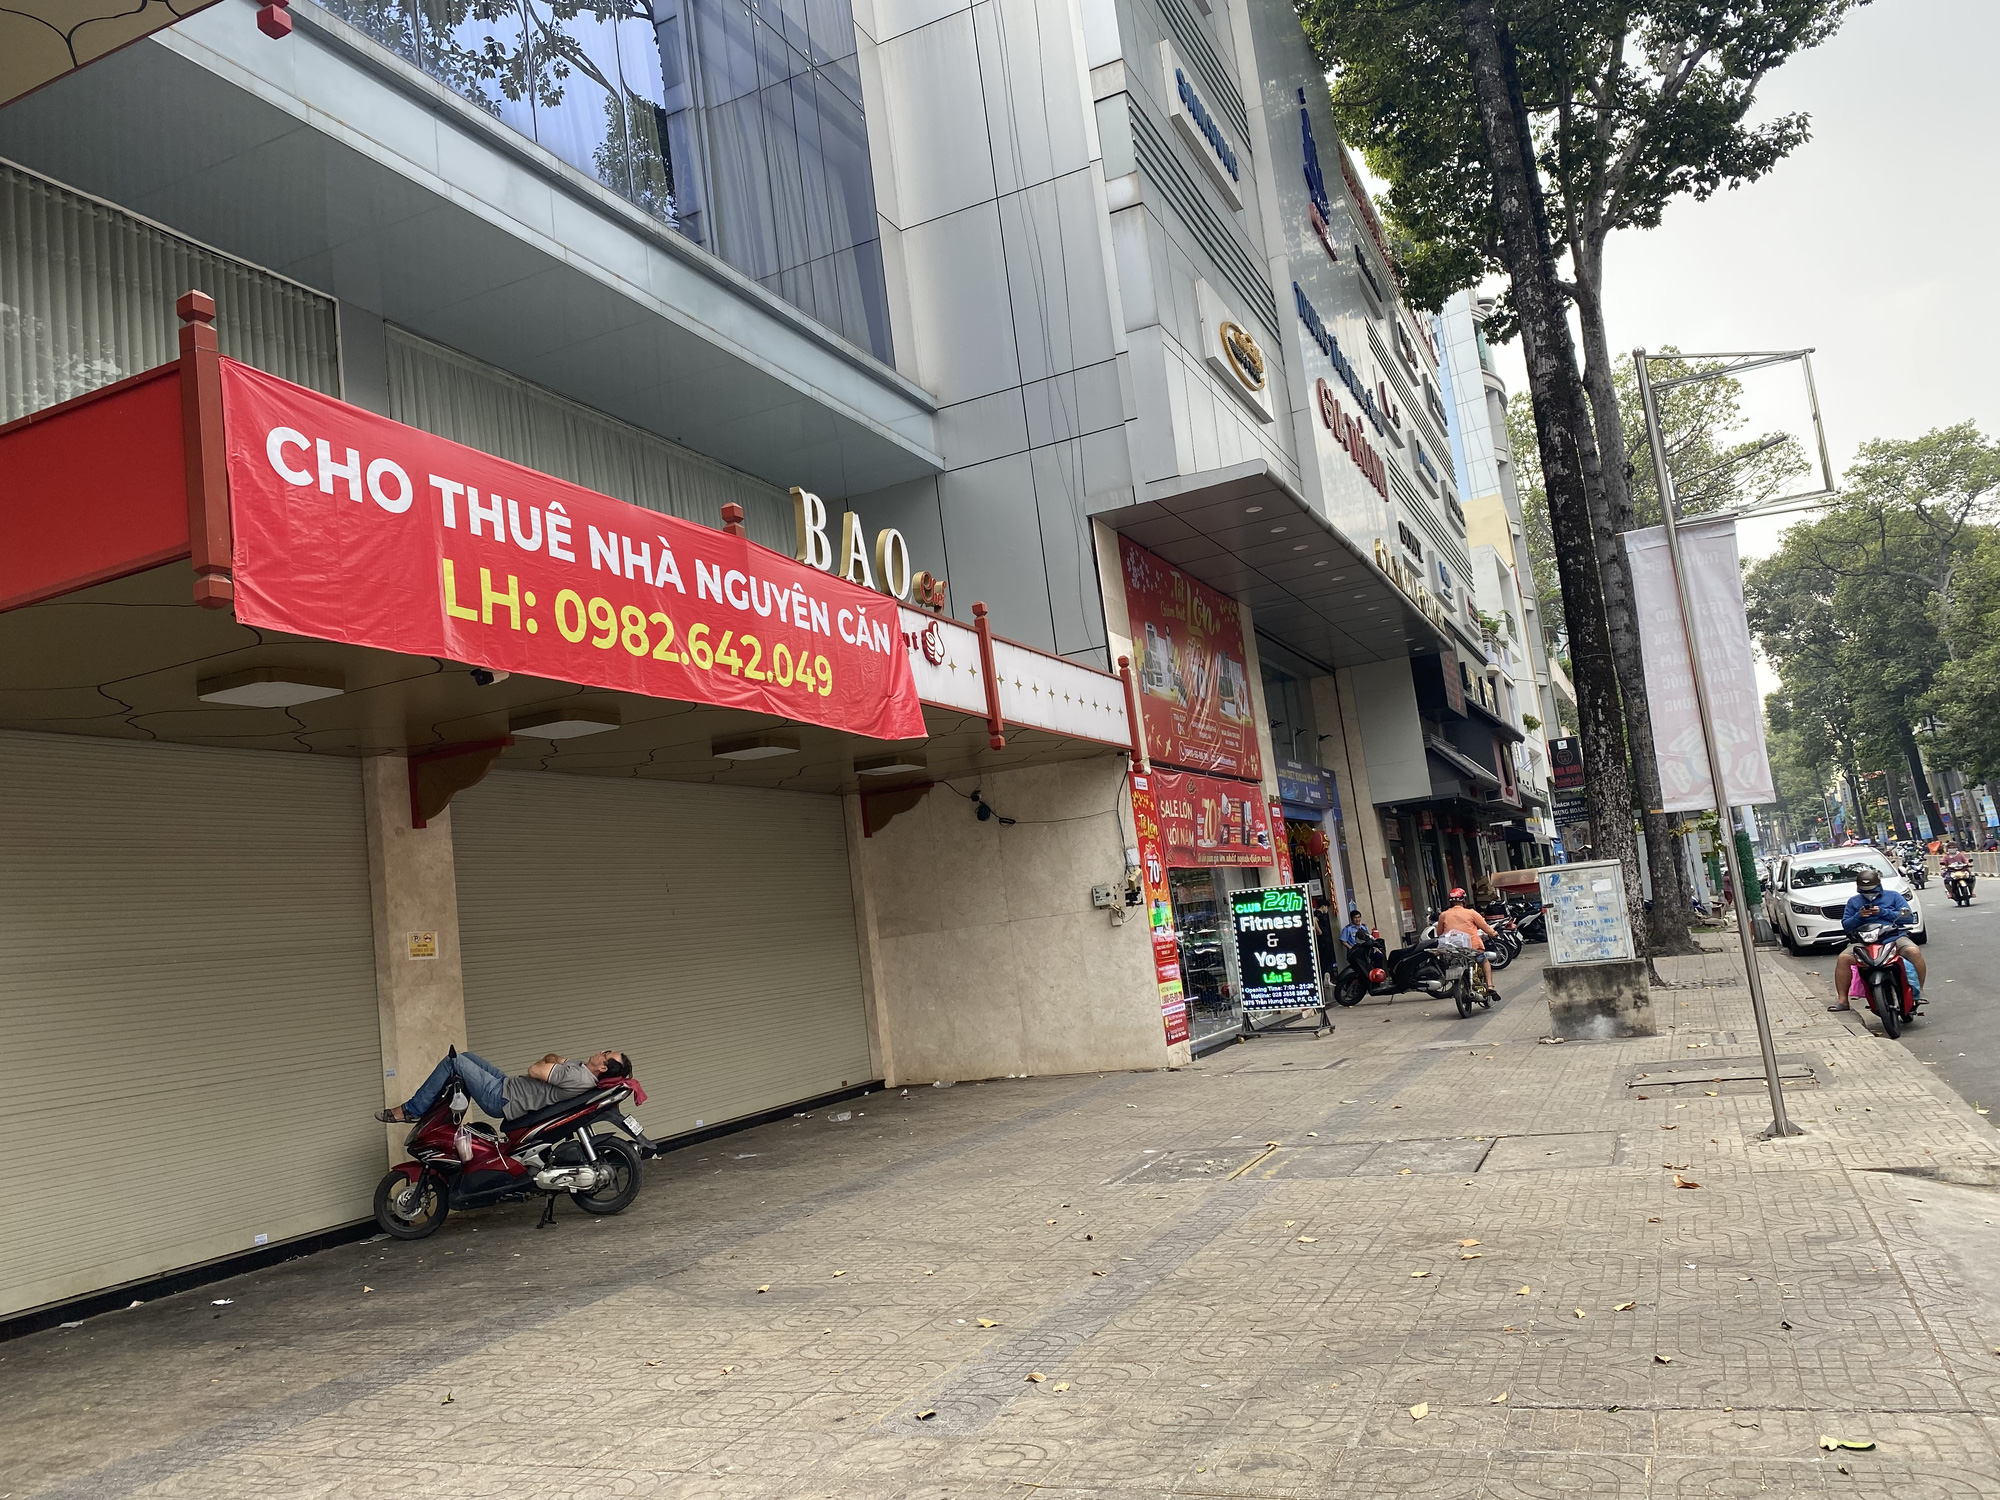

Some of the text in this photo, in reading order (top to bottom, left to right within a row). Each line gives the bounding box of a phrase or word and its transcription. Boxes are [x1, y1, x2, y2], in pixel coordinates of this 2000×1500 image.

[265, 426, 891, 656] CHO THUÊ NHÀ NGUYÊN CĂN
[790, 486, 911, 600] BAO
[442, 557, 834, 698] LH: 0982.642.049
[1160, 800, 1178, 819] SALE
[1235, 891, 1303, 914] CLUB 24h
[1239, 915, 1302, 932] Fitness
[1266, 933, 1279, 947] &
[1254, 951, 1297, 970] Yoga
[1283, 972, 1292, 982] 2
